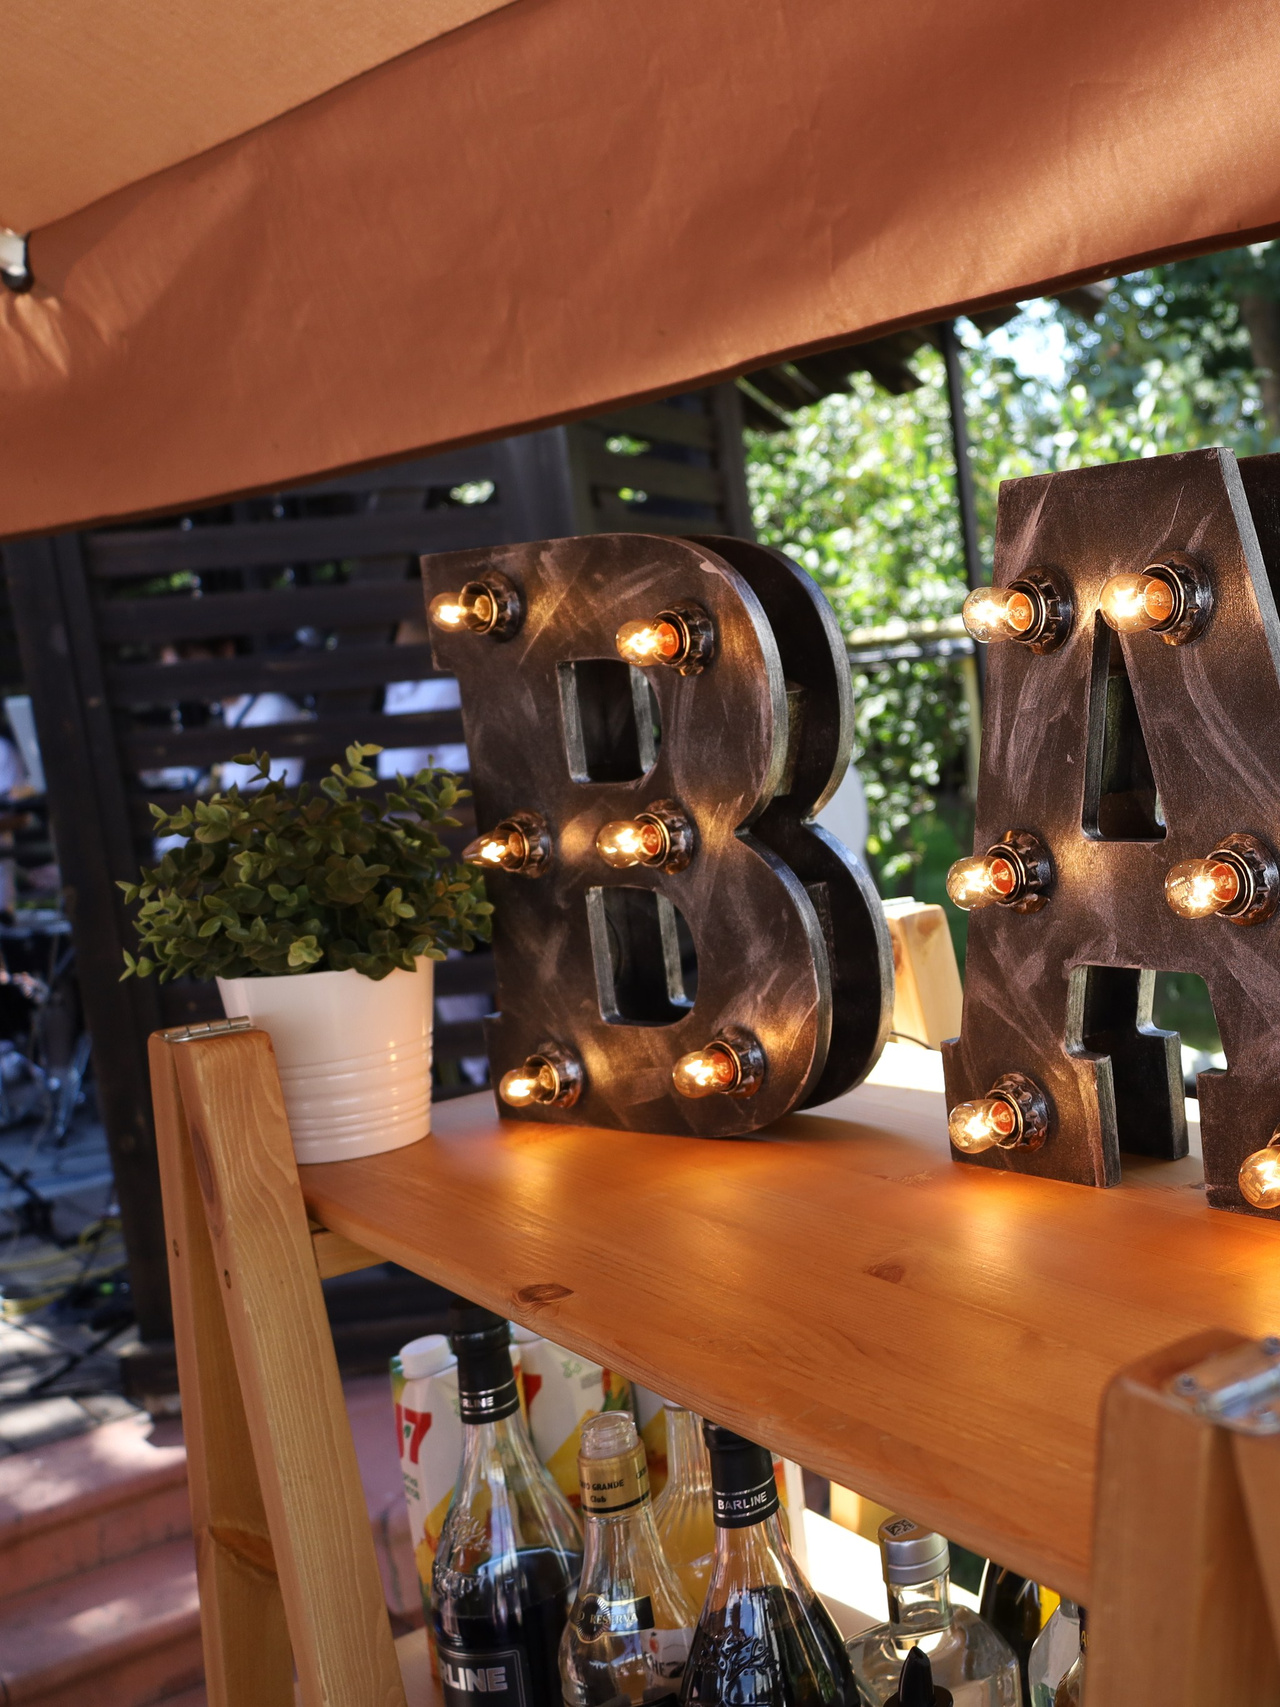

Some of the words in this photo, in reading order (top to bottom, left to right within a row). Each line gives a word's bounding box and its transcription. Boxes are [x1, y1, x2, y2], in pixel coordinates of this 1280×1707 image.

[462, 1396, 494, 1409] RLINE
[591, 1479, 624, 1491] GRANDE
[717, 1490, 767, 1511] BARLINE
[589, 1612, 638, 1625] RESERVA
